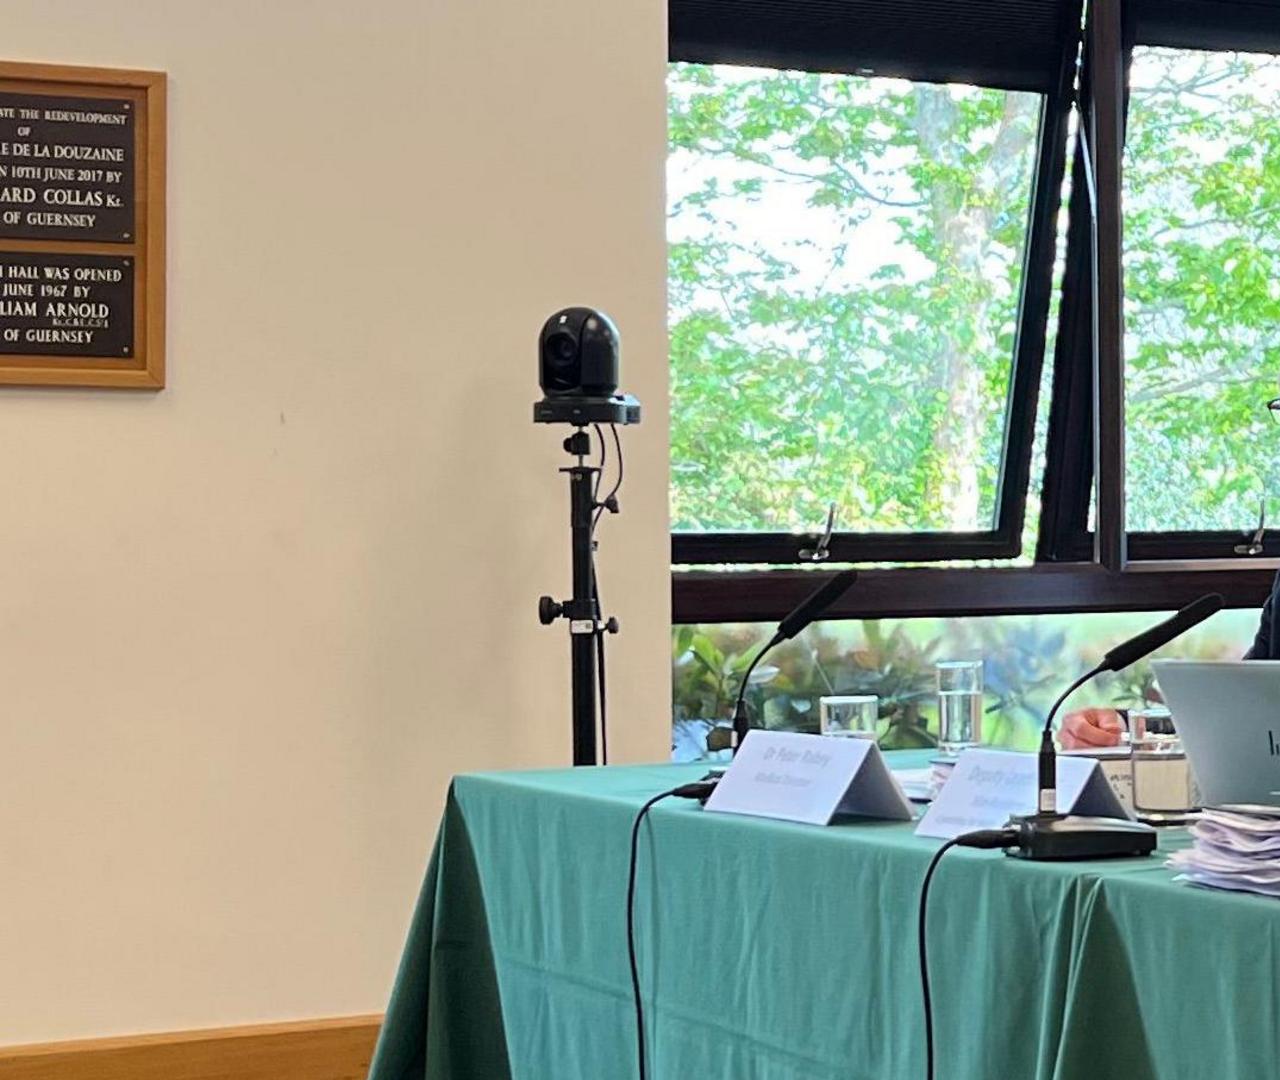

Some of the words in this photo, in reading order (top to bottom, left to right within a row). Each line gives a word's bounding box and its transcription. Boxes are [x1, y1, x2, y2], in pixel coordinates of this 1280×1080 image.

[20, 109, 39, 120] THE
[44, 110, 127, 125] REDEVELOPMENT
[17, 126, 31, 136] OF
[13, 143, 31, 157] DE
[34, 144, 50, 158] LA
[54, 145, 124, 162] DOUZAINE
[11, 166, 41, 179] 10TH
[43, 167, 75, 182] JUNE
[77, 169, 103, 182] 2017
[106, 171, 122, 183] BY
[43, 188, 103, 207] COLLAS
[3, 211, 21, 224] OF
[27, 212, 96, 227] GUERNSEY
[8, 266, 39, 279] HALL
[44, 267, 70, 280] WAS
[74, 268, 122, 282] OPENED
[3, 283, 34, 297] JUNE
[41, 285, 67, 297] 1967
[73, 286, 91, 298] BY
[45, 302, 109, 318] ARNOLD
[4, 329, 20, 342] OF
[26, 329, 94, 343] GUERNSEY
